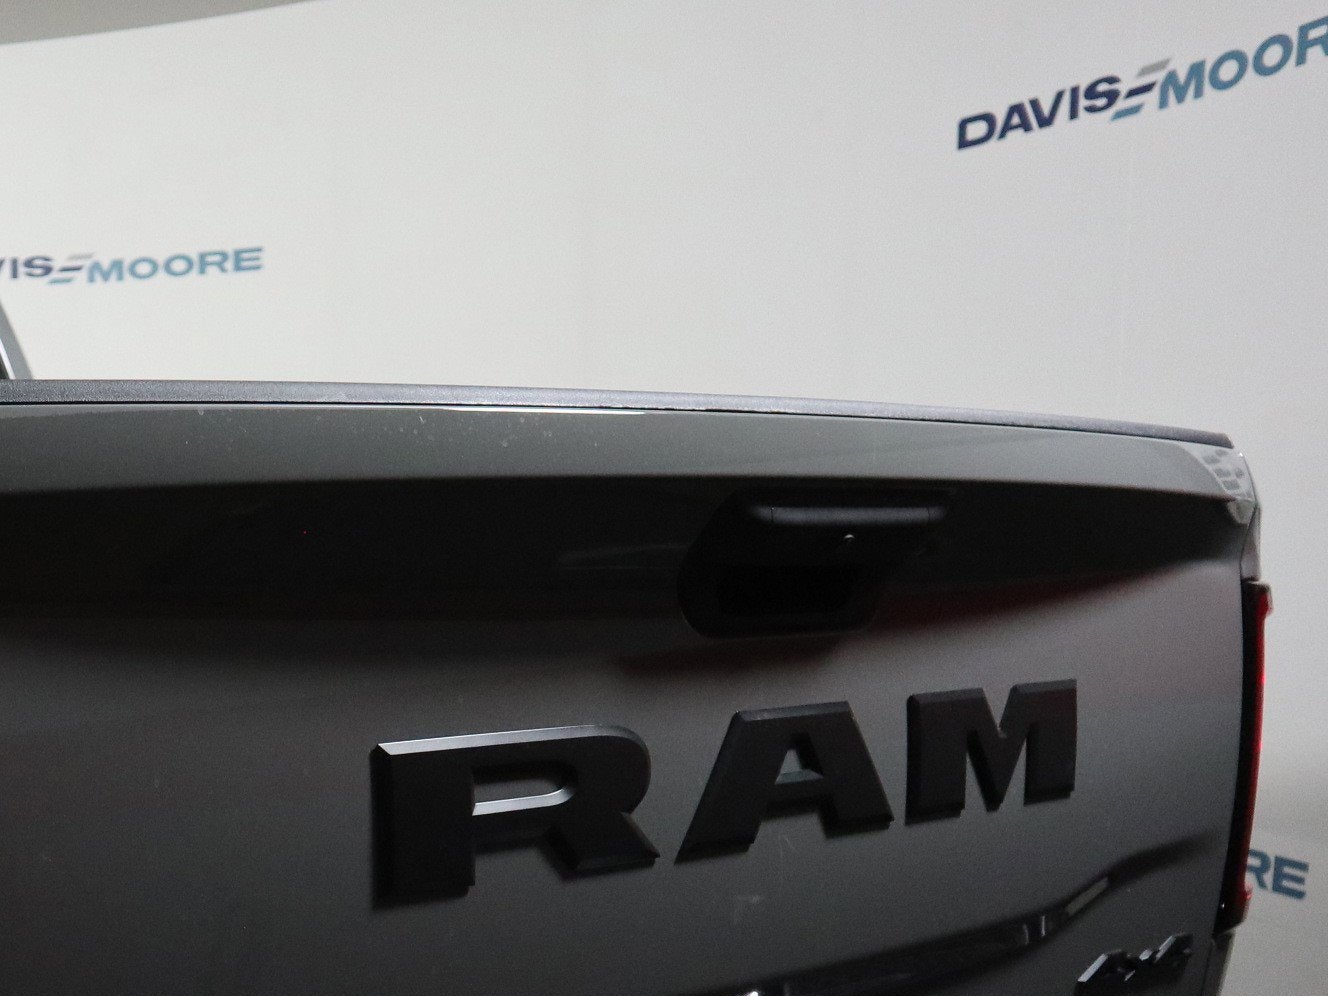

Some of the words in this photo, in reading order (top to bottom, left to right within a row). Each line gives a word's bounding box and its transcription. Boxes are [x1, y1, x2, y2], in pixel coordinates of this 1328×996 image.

[956, 74, 1122, 150] DAVIS
[86, 246, 264, 283] MOORE
[371, 678, 1077, 908] RAM
